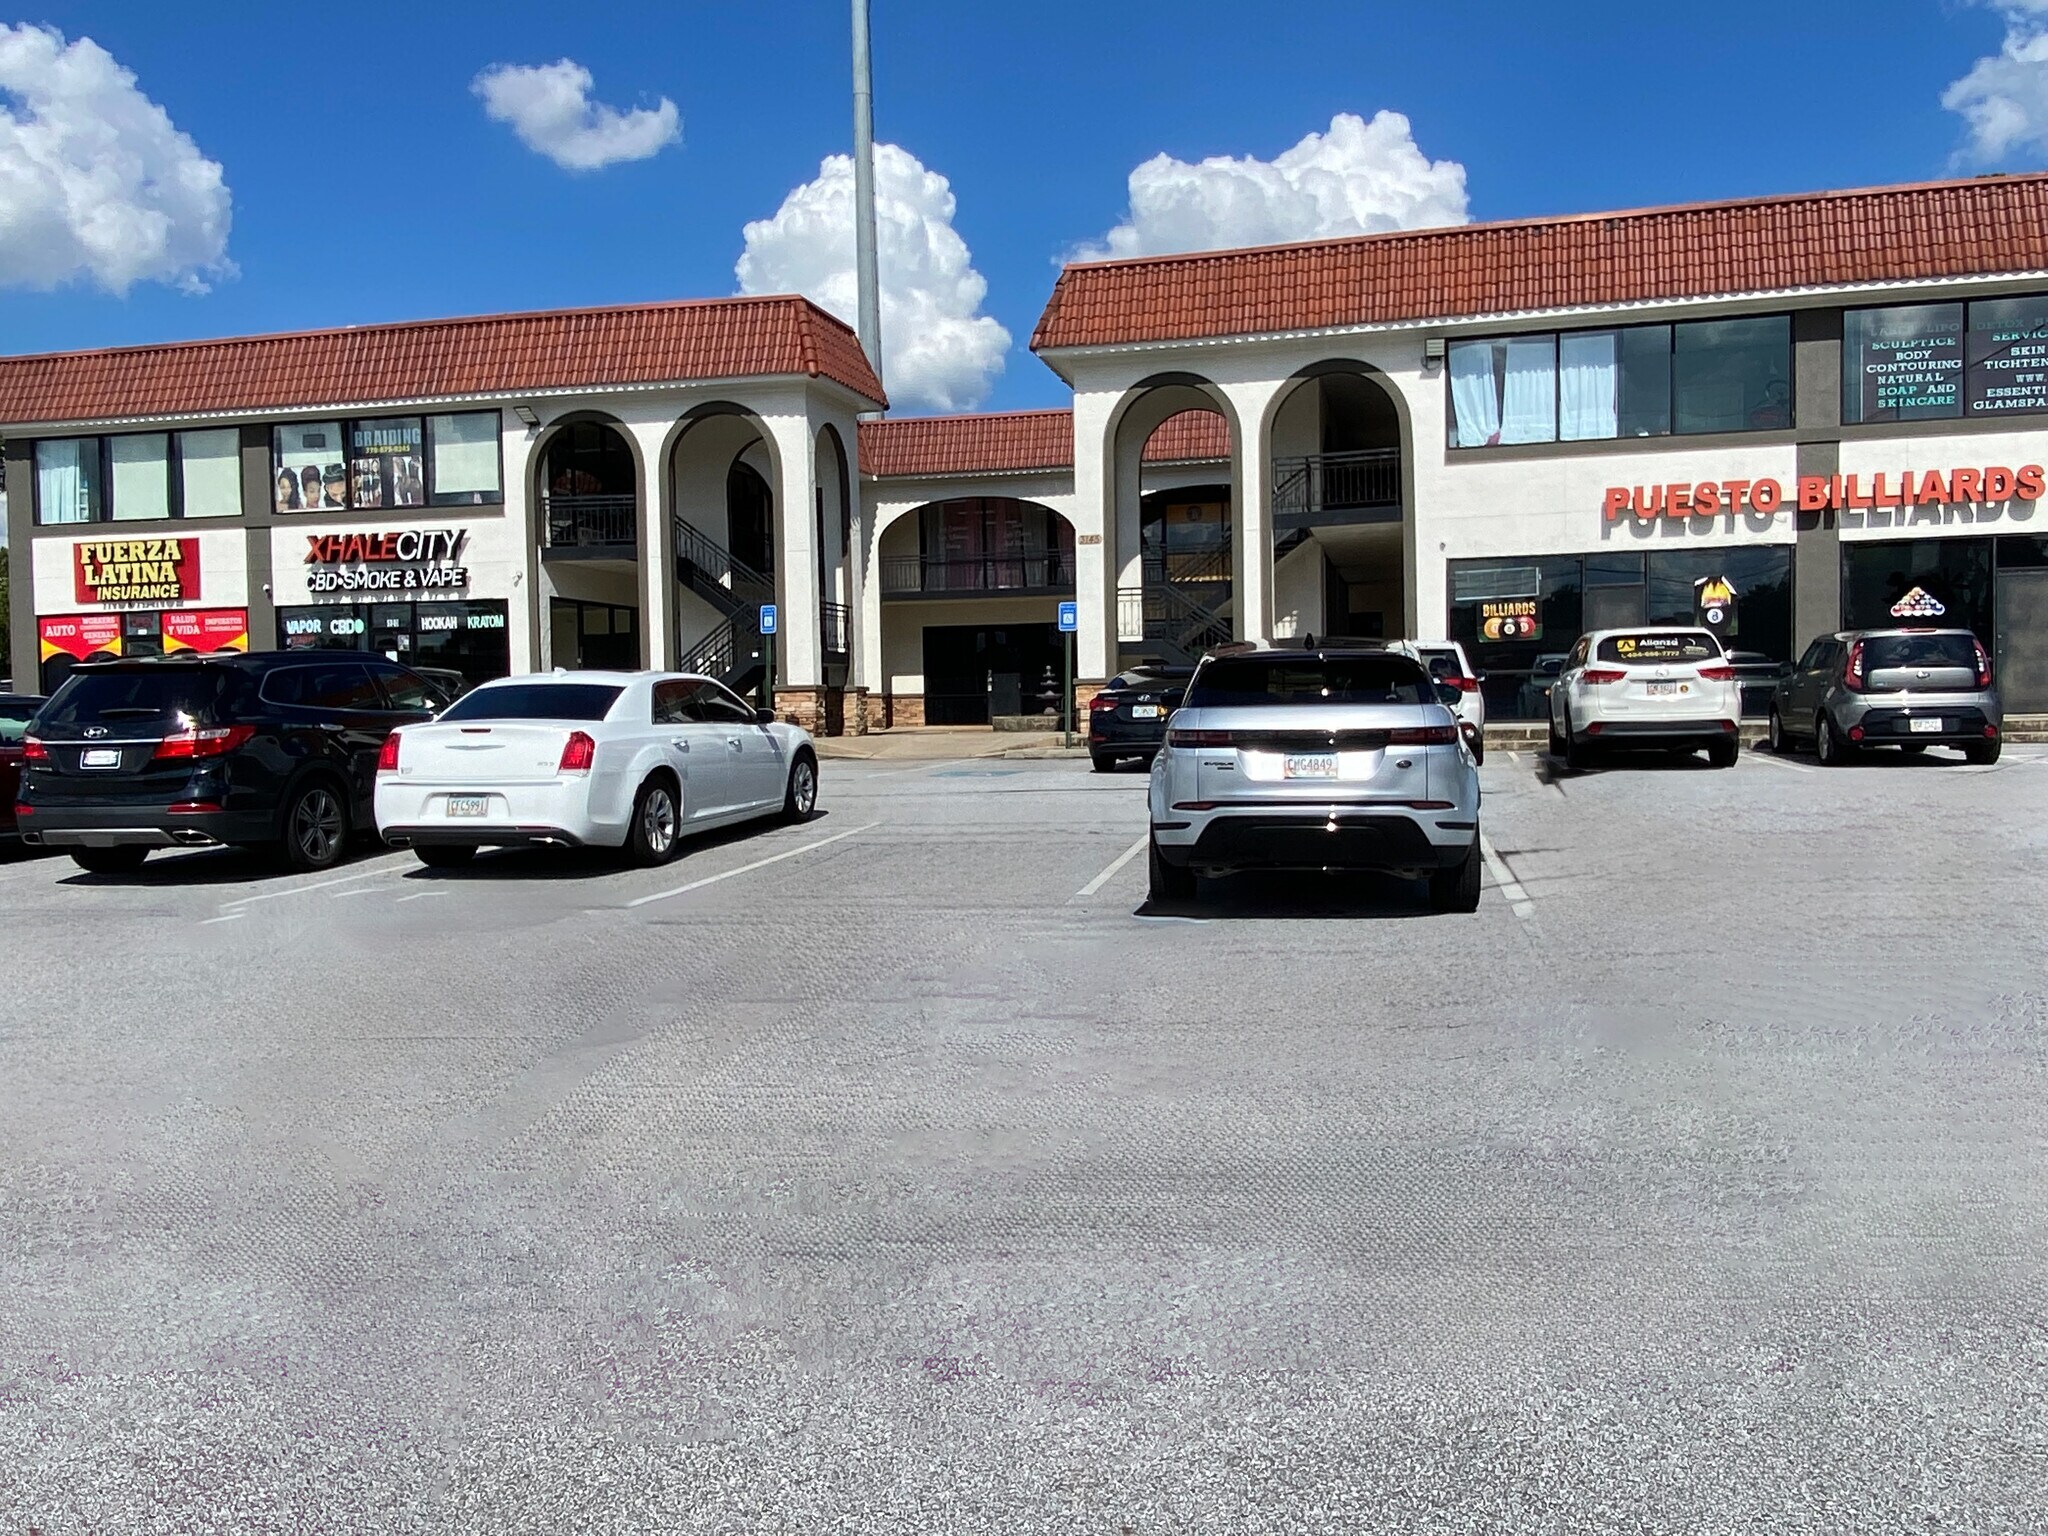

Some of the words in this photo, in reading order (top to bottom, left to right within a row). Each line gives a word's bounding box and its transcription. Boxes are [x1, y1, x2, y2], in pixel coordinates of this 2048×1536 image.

[1872, 337, 1956, 350] SCULPTICE
[1896, 350, 1932, 361] BODY
[2010, 345, 2046, 356] SKIN
[1866, 360, 1962, 373] CONTOURING
[1877, 372, 1944, 385] NATURAL
[1878, 385, 1917, 396] SOAP
[1926, 384, 1956, 394] AND
[1878, 396, 1955, 408] SKINCARE
[354, 428, 420, 447] BRAIDING
[1605, 478, 1782, 521] PUESTO
[1799, 464, 2046, 511] BILLIARDS
[80, 539, 181, 564] FUERZA
[84, 561, 177, 586] LATINA
[404, 569, 417, 588] &
[420, 568, 464, 587] VAPE
[97, 584, 180, 600] INSURANCE
[1482, 601, 1536, 617] BILLIARDS
[170, 614, 197, 624] SALUD
[421, 616, 458, 631] HOOKAH
[467, 615, 504, 629] KRATOM
[45, 624, 76, 637] AUTO
[167, 625, 174, 635] Y
[176, 624, 201, 635] VIDA
[286, 619, 321, 634] VAPOR
